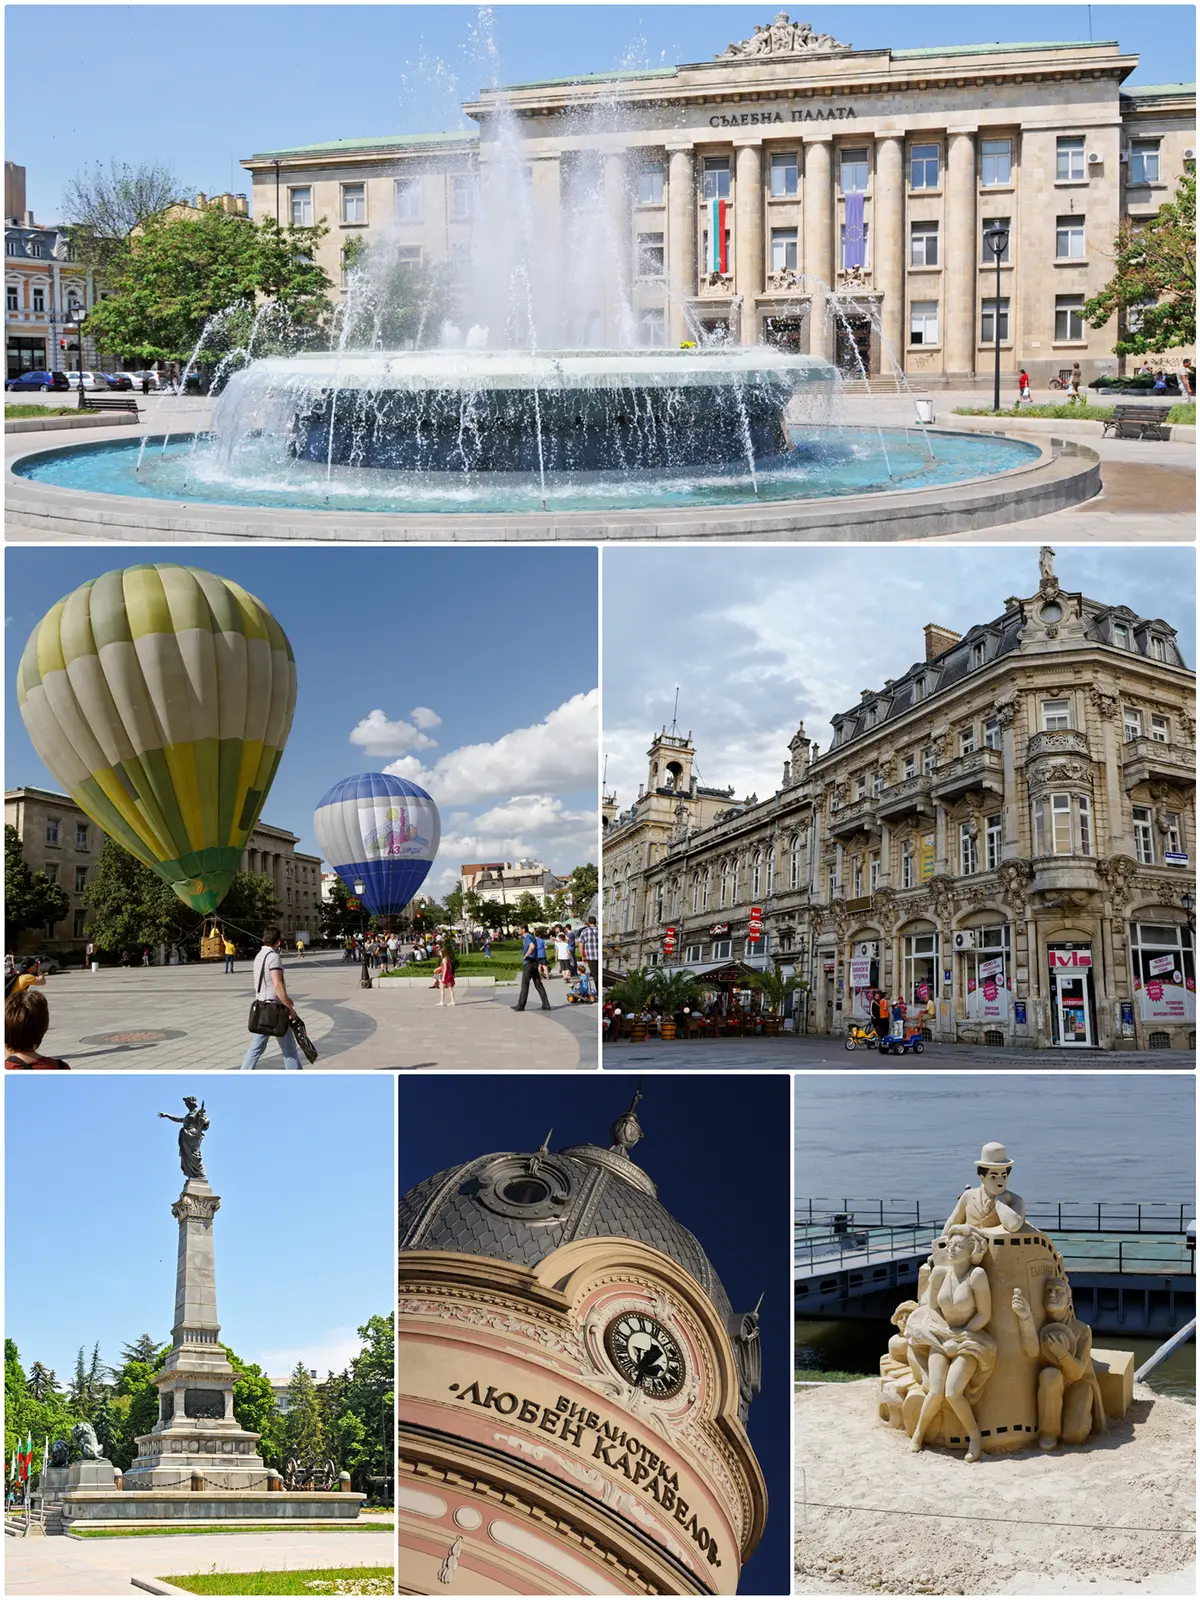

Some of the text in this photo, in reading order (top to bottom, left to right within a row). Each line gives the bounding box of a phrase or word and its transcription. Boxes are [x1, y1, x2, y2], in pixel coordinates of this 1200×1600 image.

[709, 107, 858, 128] СЪДЕБНА ПАЛАТА
[455, 1381, 719, 1566] ЛЮБЕН КАРАВЕЛОВ
[555, 1395, 679, 1491] БИБЛИОТЕКА
